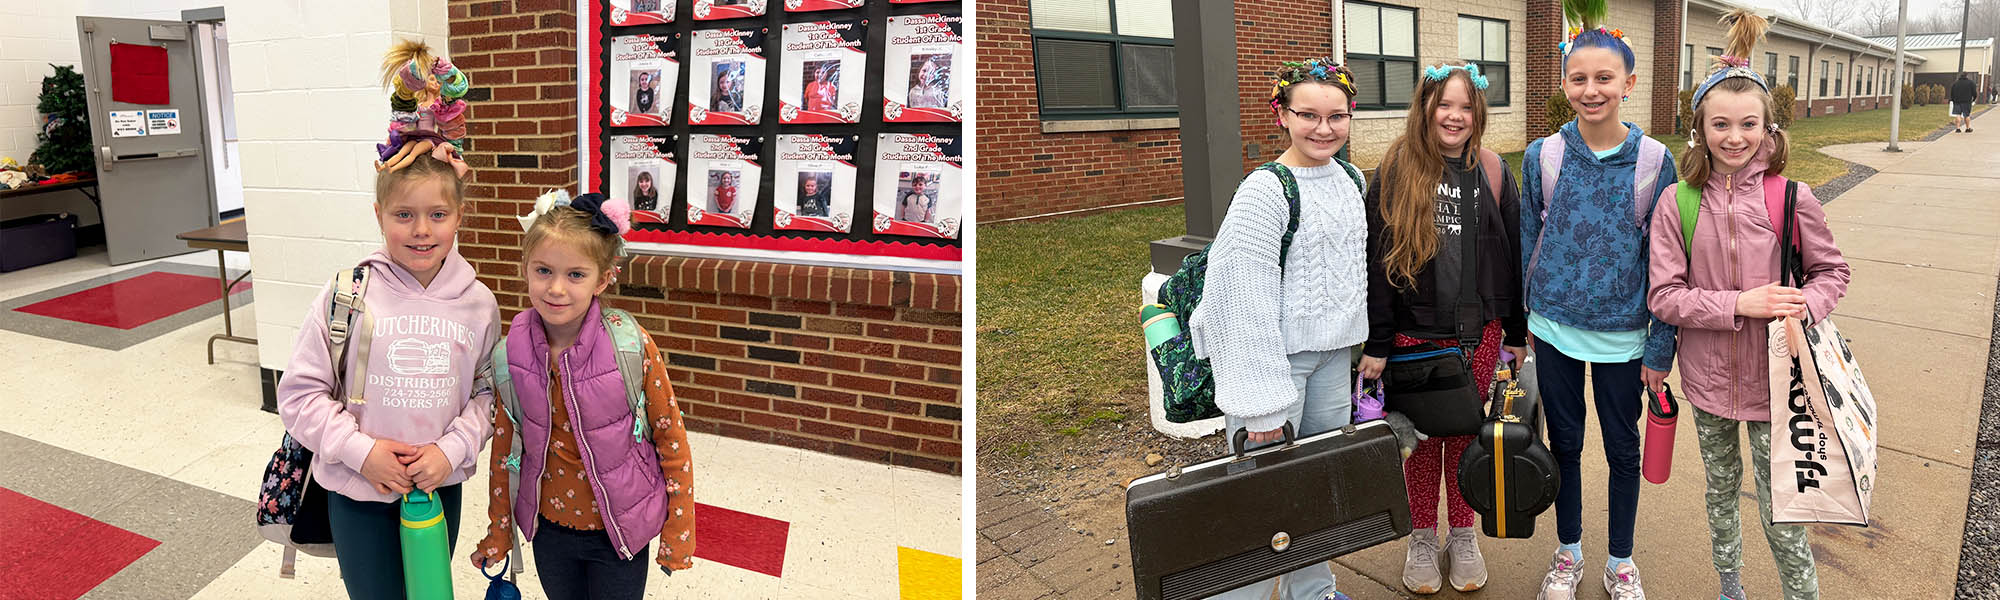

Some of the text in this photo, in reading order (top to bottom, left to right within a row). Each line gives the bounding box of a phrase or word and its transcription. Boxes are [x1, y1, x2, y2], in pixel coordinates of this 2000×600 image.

[904, 17, 926, 25] Dassa
[798, 24, 818, 32] Dassa
[928, 25, 951, 33] Grade
[820, 32, 840, 40] Grade
[892, 36, 921, 45] Student
[922, 35, 933, 43] Of
[934, 34, 948, 42] The
[787, 42, 813, 51] Student
[838, 39, 861, 48] Month
[810, 136, 843, 144] McKinney
[895, 135, 953, 145] Dassa McKinney
[813, 144, 833, 152] Grade
[903, 144, 942, 153] 2nd Grade
[781, 152, 806, 160] Student
[881, 152, 962, 163] Student Of The Month
[372, 315, 475, 351] UTCHERINE'S
[383, 397, 449, 408] BOYERS PA
[1817, 432, 1828, 461] shop
